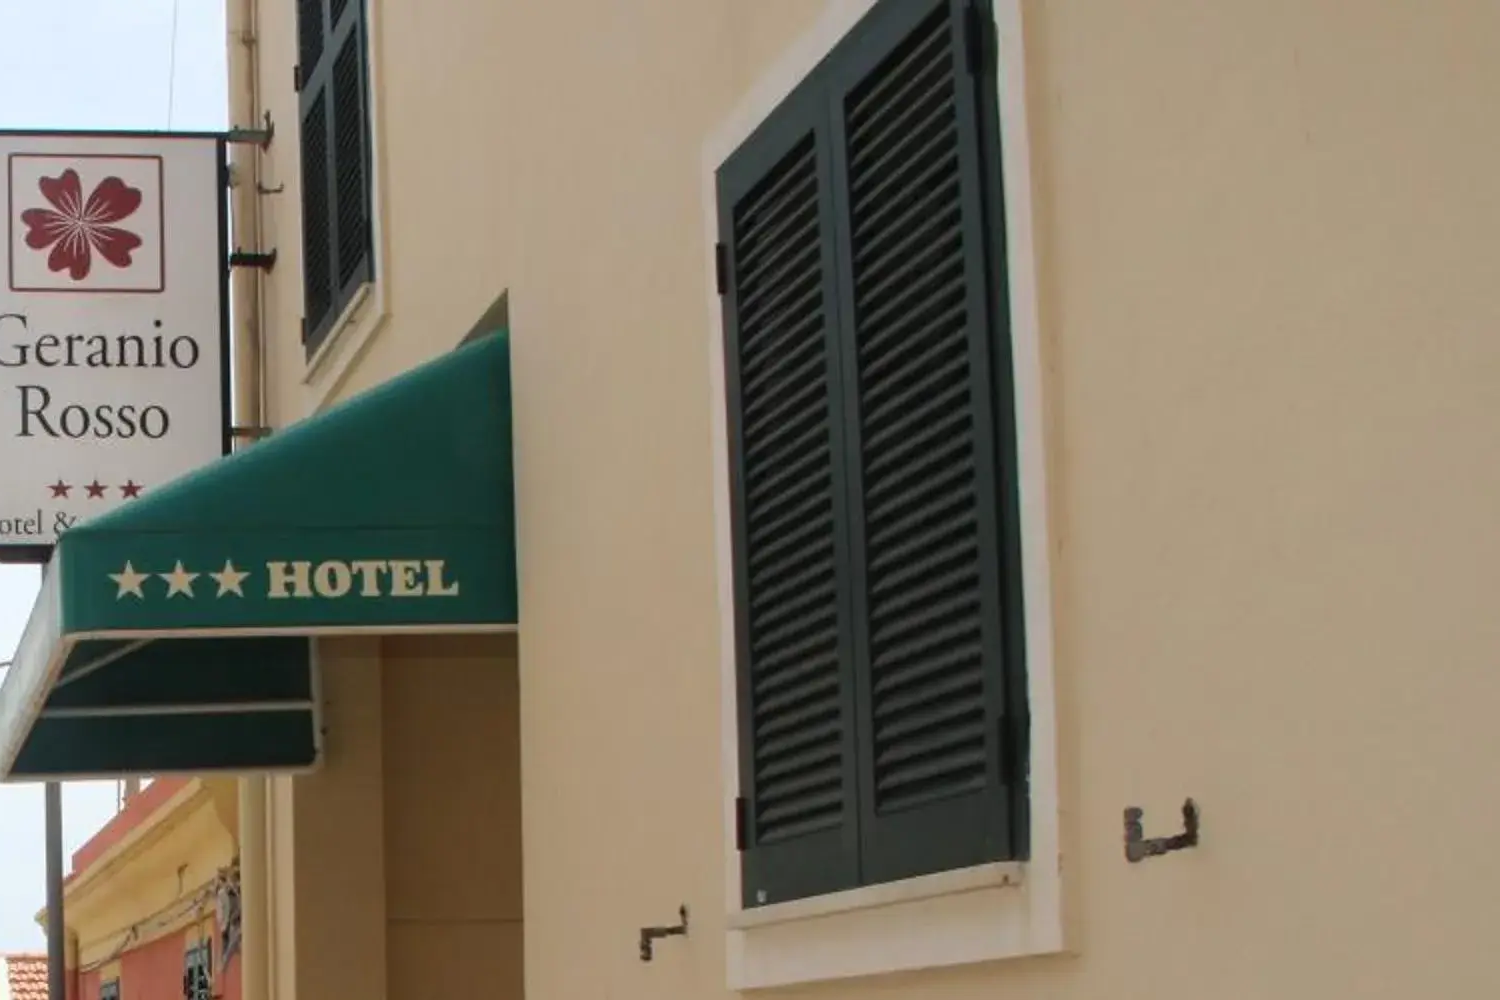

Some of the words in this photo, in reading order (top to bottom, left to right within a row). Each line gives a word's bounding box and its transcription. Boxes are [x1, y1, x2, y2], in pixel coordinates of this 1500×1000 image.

[15, 384, 170, 439] Rosso
[53, 511, 77, 535] &
[266, 560, 460, 598] HOTEL
